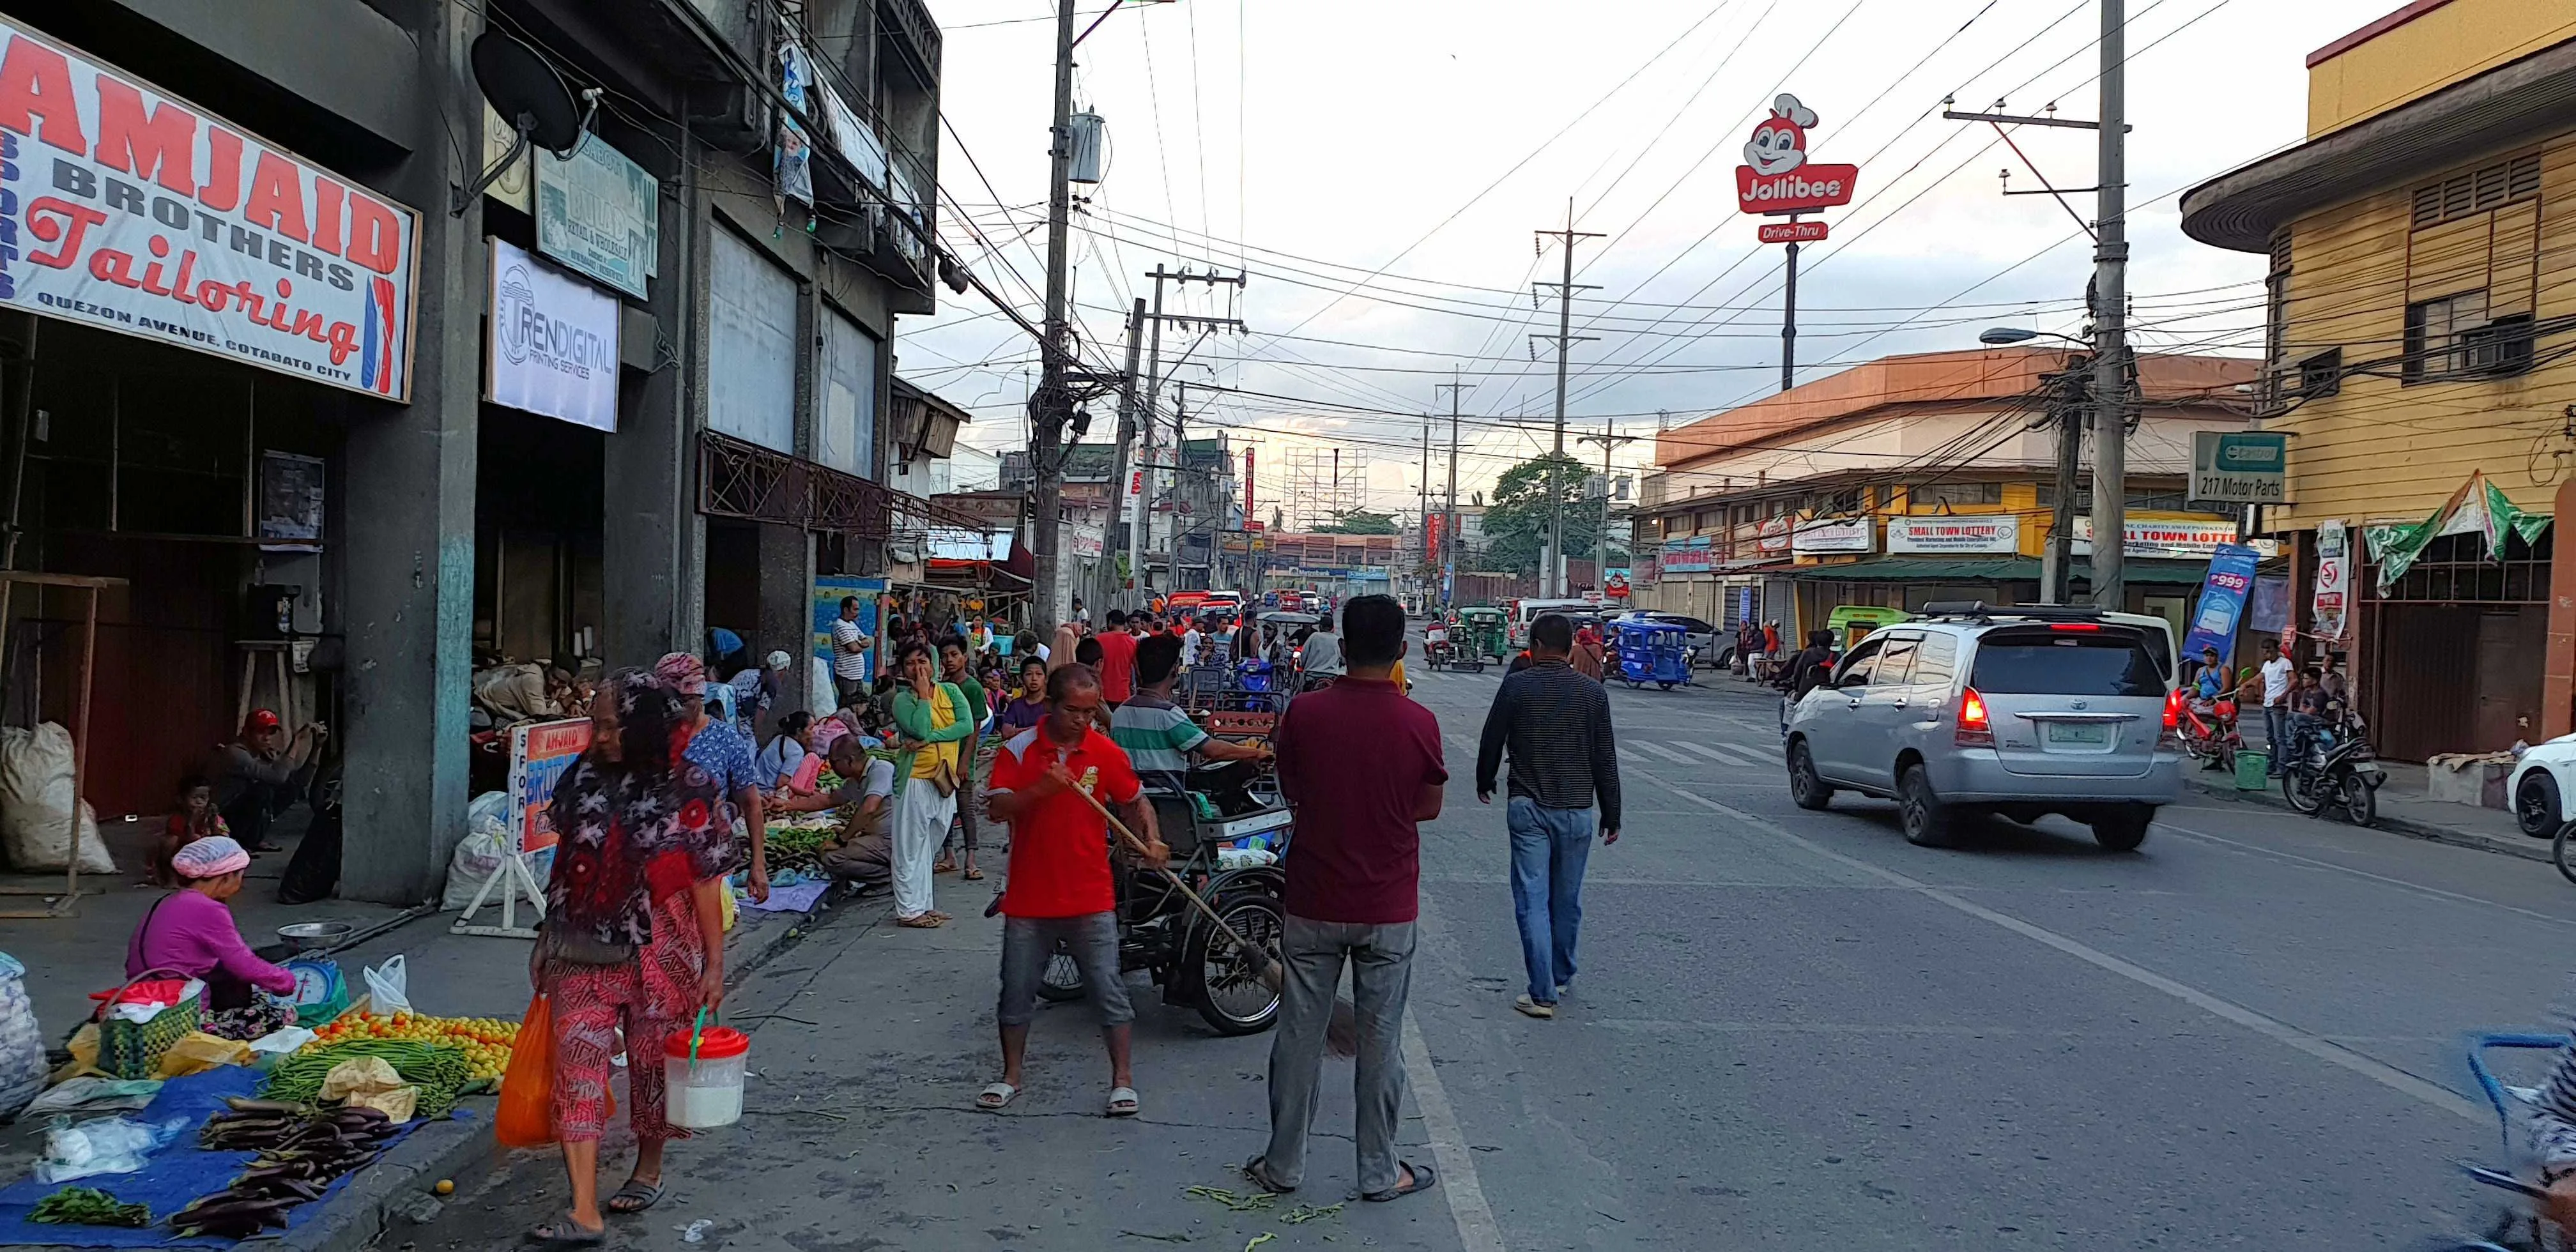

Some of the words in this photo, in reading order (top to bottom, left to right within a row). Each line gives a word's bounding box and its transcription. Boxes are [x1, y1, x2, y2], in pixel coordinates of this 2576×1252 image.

[0, 34, 400, 275] AMJAID
[1742, 175, 1841, 201] Jollibee
[52, 158, 354, 292] BROTHERS
[1763, 225, 1820, 239] Drive-Thru
[26, 195, 360, 366] Tailoring
[38, 292, 131, 323] QUEZON
[226, 340, 312, 370] COTABATO
[317, 365, 351, 381] CITY
[529, 349, 558, 370] PRINTING
[560, 360, 590, 380] SERVICES
[2239, 448, 2275, 459] Castrol
[2201, 477, 2220, 495] 217
[2222, 478, 2253, 496] Motor
[2256, 478, 2280, 496] Parts
[1908, 526, 1933, 536] SMALL
[1936, 526, 1959, 535] TOWN
[1961, 526, 1996, 535] LOTTERY
[2141, 531, 2188, 541] TOWN
[2193, 533, 2237, 542] LOTTE
[516, 734, 526, 851] SPORTS
